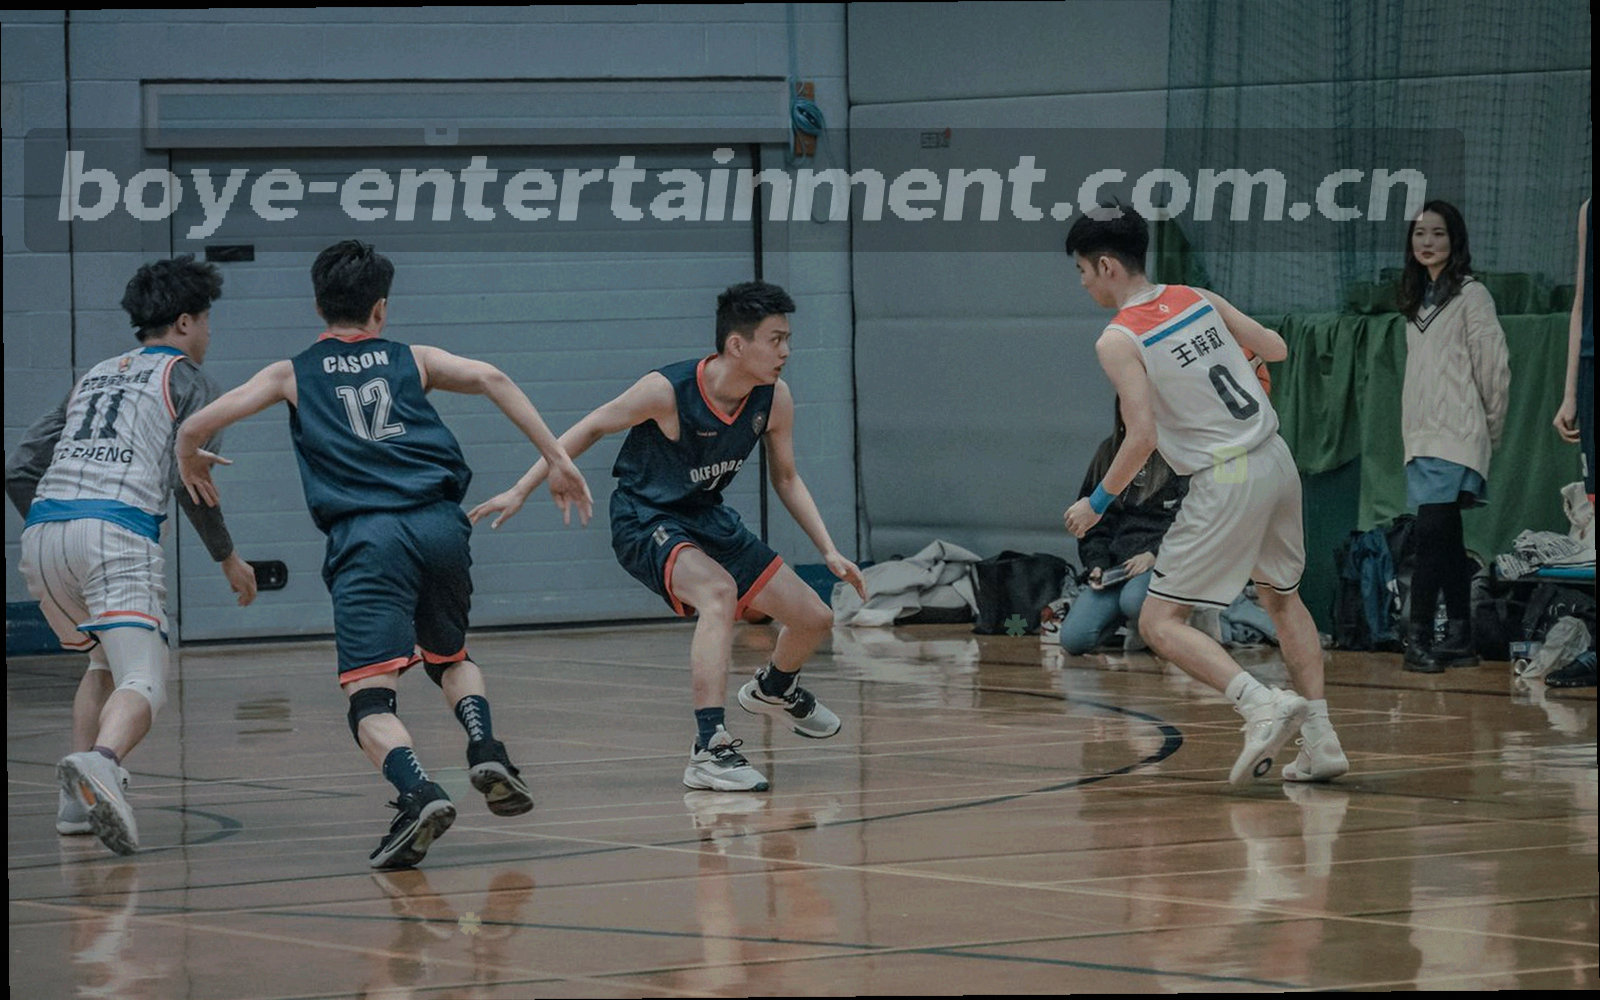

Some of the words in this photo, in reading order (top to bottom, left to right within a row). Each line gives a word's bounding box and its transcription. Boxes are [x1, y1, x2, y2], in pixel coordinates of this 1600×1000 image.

[322, 350, 390, 374] CASON
[73, 388, 126, 441] 11
[335, 377, 407, 442] 12
[1208, 363, 1260, 421] 0
